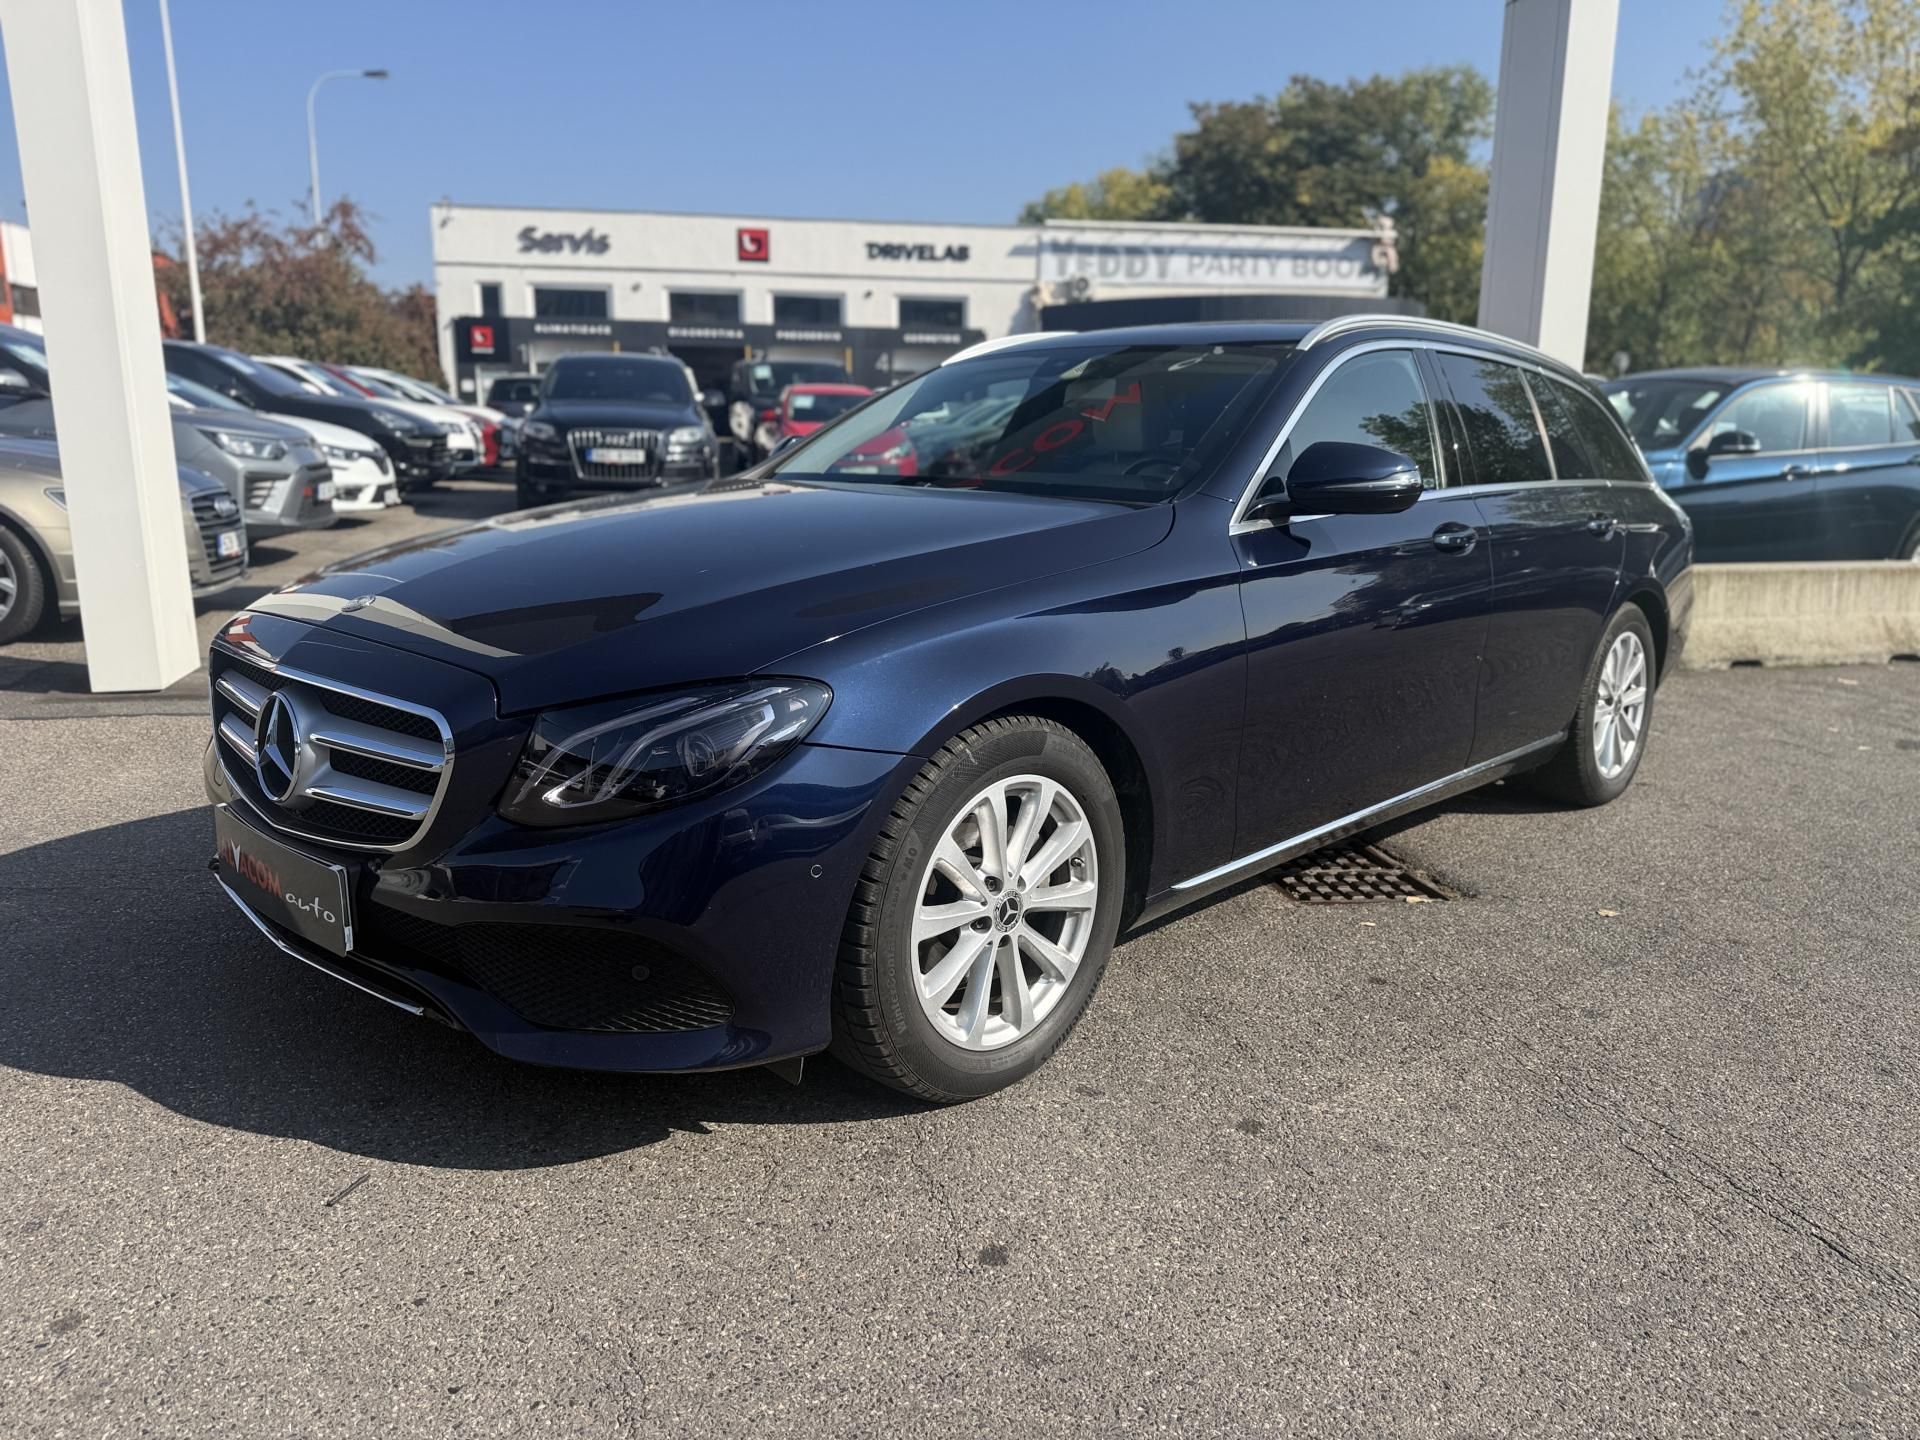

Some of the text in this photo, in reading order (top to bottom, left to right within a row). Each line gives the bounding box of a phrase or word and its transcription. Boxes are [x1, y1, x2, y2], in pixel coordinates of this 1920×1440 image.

[517, 226, 611, 255] Servis
[866, 242, 970, 262] DRIVELAB
[1186, 252, 1283, 279] PARTY
[285, 892, 336, 924] auto
